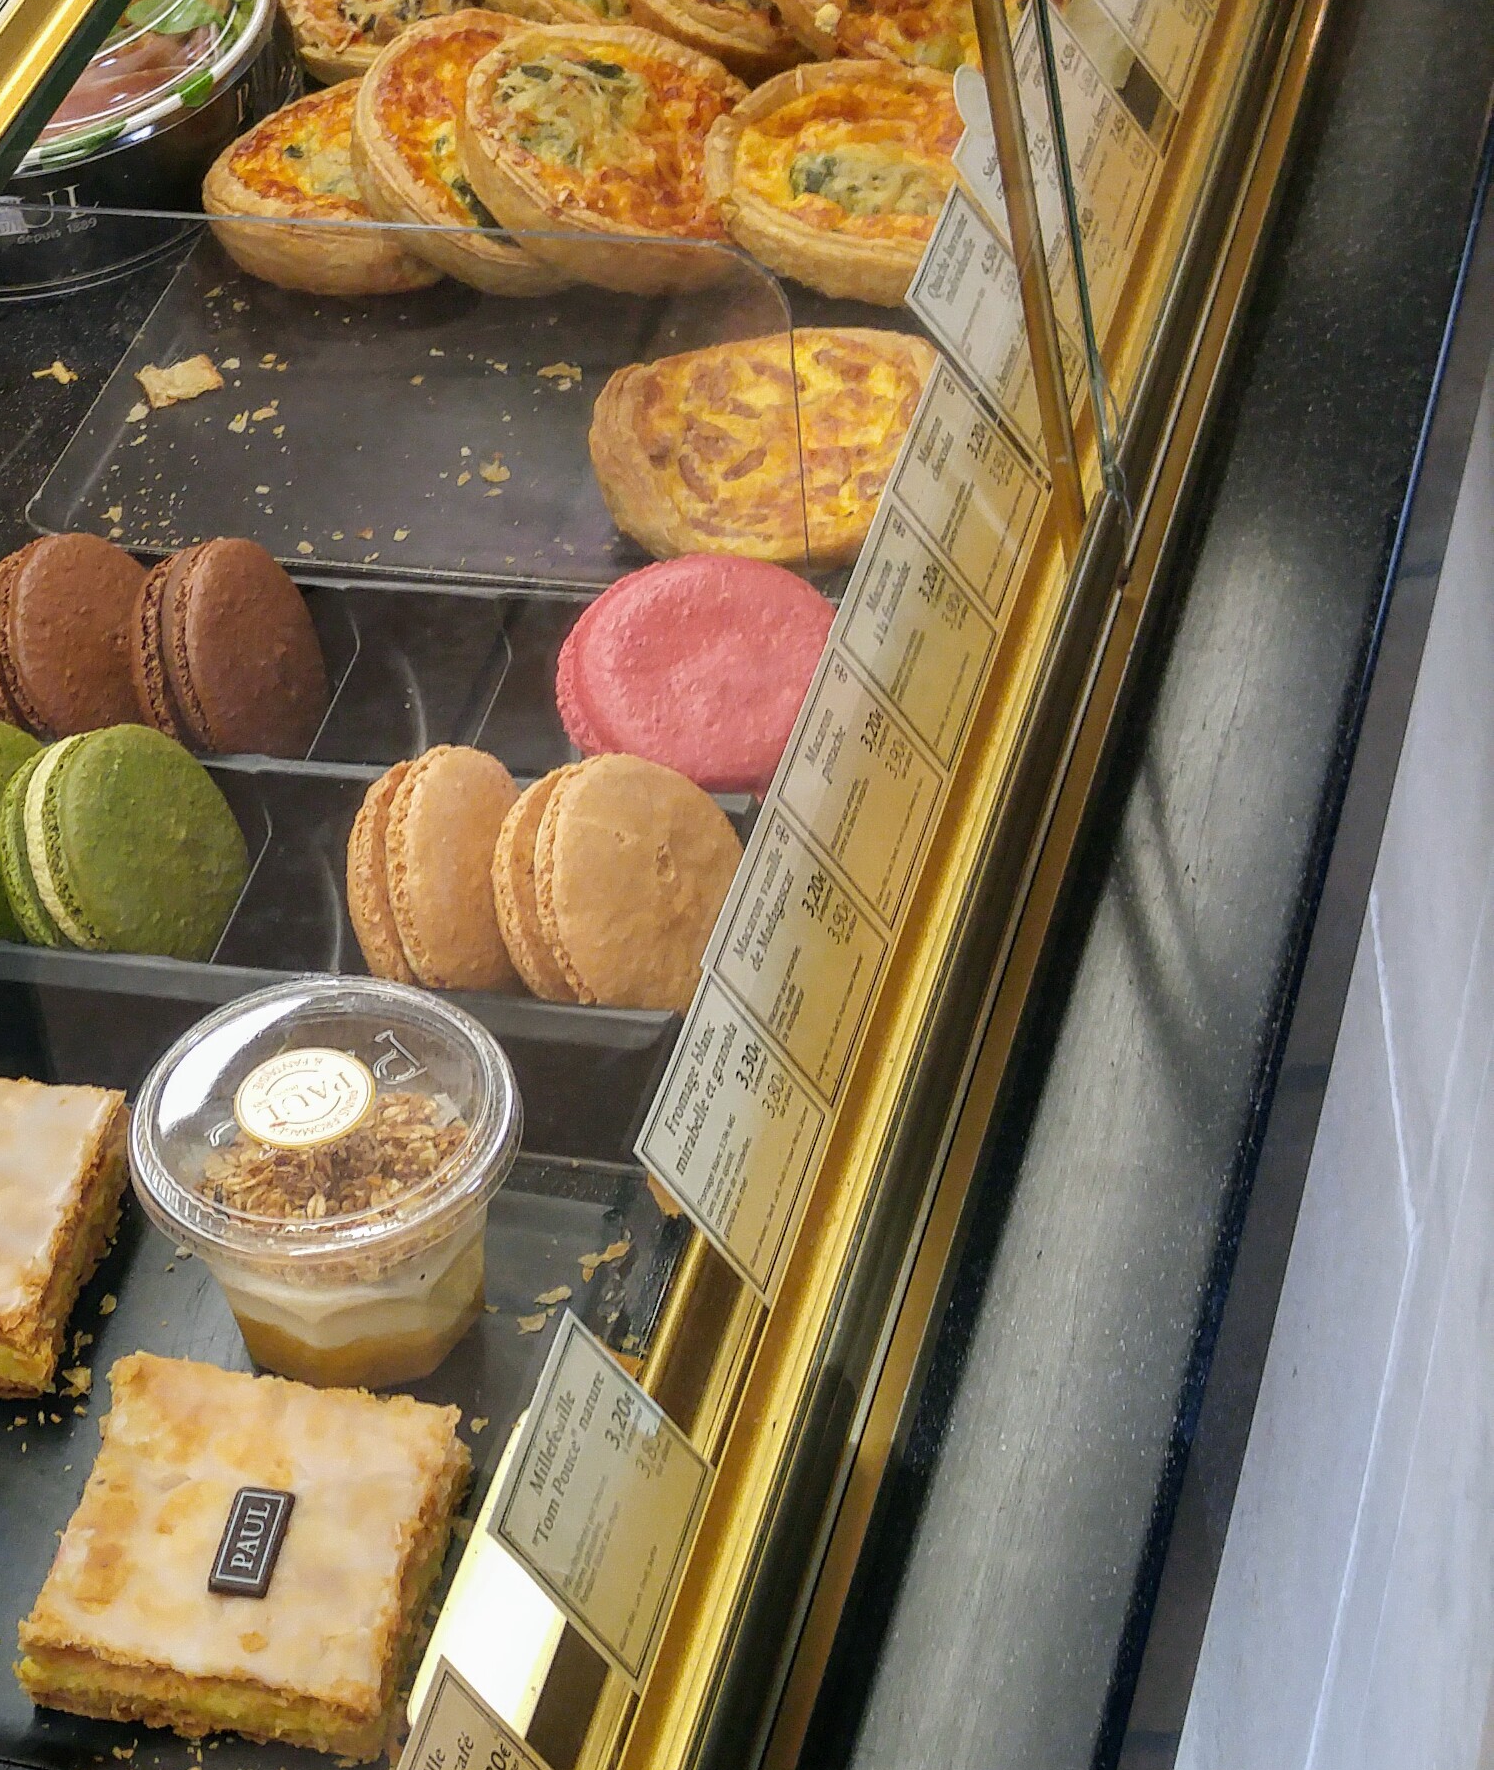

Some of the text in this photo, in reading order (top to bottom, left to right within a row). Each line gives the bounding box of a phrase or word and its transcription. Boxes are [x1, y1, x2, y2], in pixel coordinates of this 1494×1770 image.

[916, 415, 942, 467] Macaron
[930, 431, 954, 482] chocolat
[865, 559, 892, 614] Macaron
[804, 707, 833, 767] Macaron
[821, 724, 846, 785] pistache
[859, 708, 884, 753] 3,20€
[732, 847, 783, 961] Macaron vanille
[756, 868, 794, 953] Madagascar
[801, 870, 827, 918] 3,20€
[826, 900, 851, 945] 3,90€
[749, 950, 764, 972] de
[664, 1020, 715, 1136] Fromage blanc
[735, 1041, 761, 1090] 3,30€
[256, 1071, 353, 1120] PAUL
[675, 1021, 737, 1175] mirabelle et granola
[761, 1072, 786, 1119] 3,80€
[529, 1390, 575, 1495] Millefeuille
[604, 1391, 634, 1450] 3,20€
[531, 1371, 604, 1546] "Tom Pouce" nature
[230, 1502, 272, 1571] PAUL
